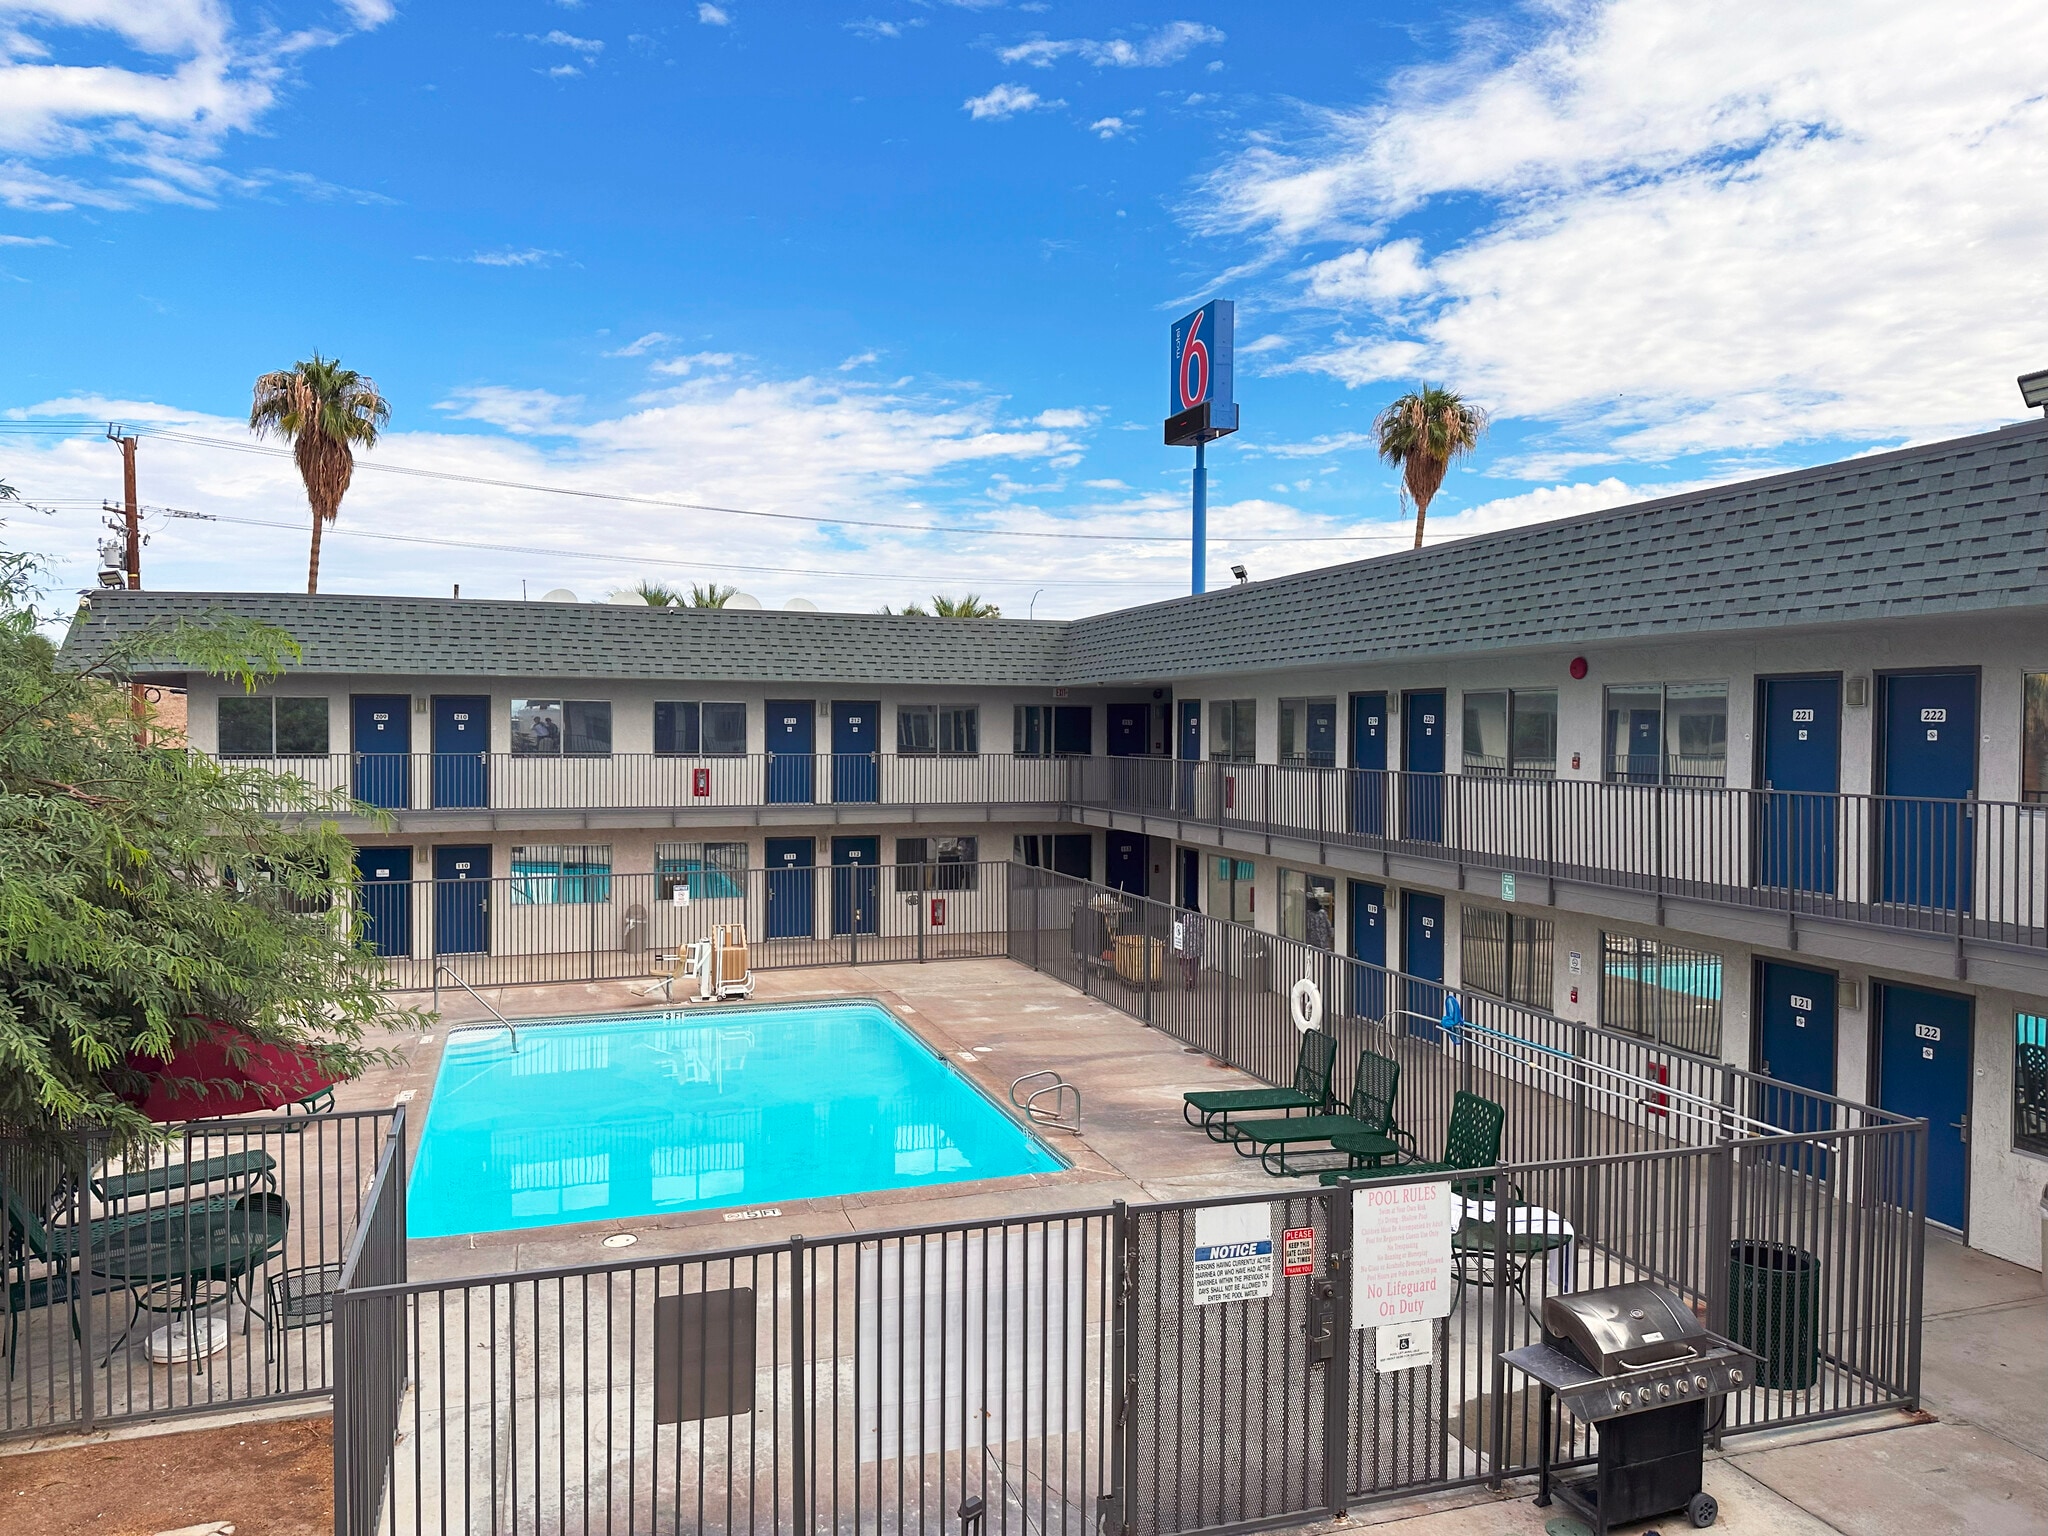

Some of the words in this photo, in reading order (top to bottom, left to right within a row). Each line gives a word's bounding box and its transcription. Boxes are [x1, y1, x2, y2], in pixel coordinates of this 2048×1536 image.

[1179, 310, 1209, 409] 6
[1795, 711, 1811, 720] 221
[1923, 711, 1944, 720] 222
[1793, 997, 1809, 1009] 121
[666, 1012, 671, 1020] 3
[1918, 1026, 1937, 1039] 122
[1368, 1190, 1399, 1207] POOL
[1403, 1185, 1436, 1203] RULES
[1286, 1230, 1312, 1239] PLEASE
[1210, 1242, 1258, 1259] NOTICE
[1297, 1248, 1311, 1256] CLOSED
[1232, 1258, 1256, 1267] CURRENTLY
[1257, 1256, 1271, 1264] ACTIVE
[1195, 1271, 1216, 1279] DIARRHEA
[1257, 1264, 1271, 1272] ACTIVE
[1197, 1279, 1217, 1287] DIARRHEA
[1243, 1273, 1264, 1281] PREVIOUS
[1367, 1284, 1382, 1299] No
[1387, 1277, 1436, 1297] Lifeguard
[1380, 1301, 1395, 1317] On
[1400, 1299, 1424, 1315] Duty
